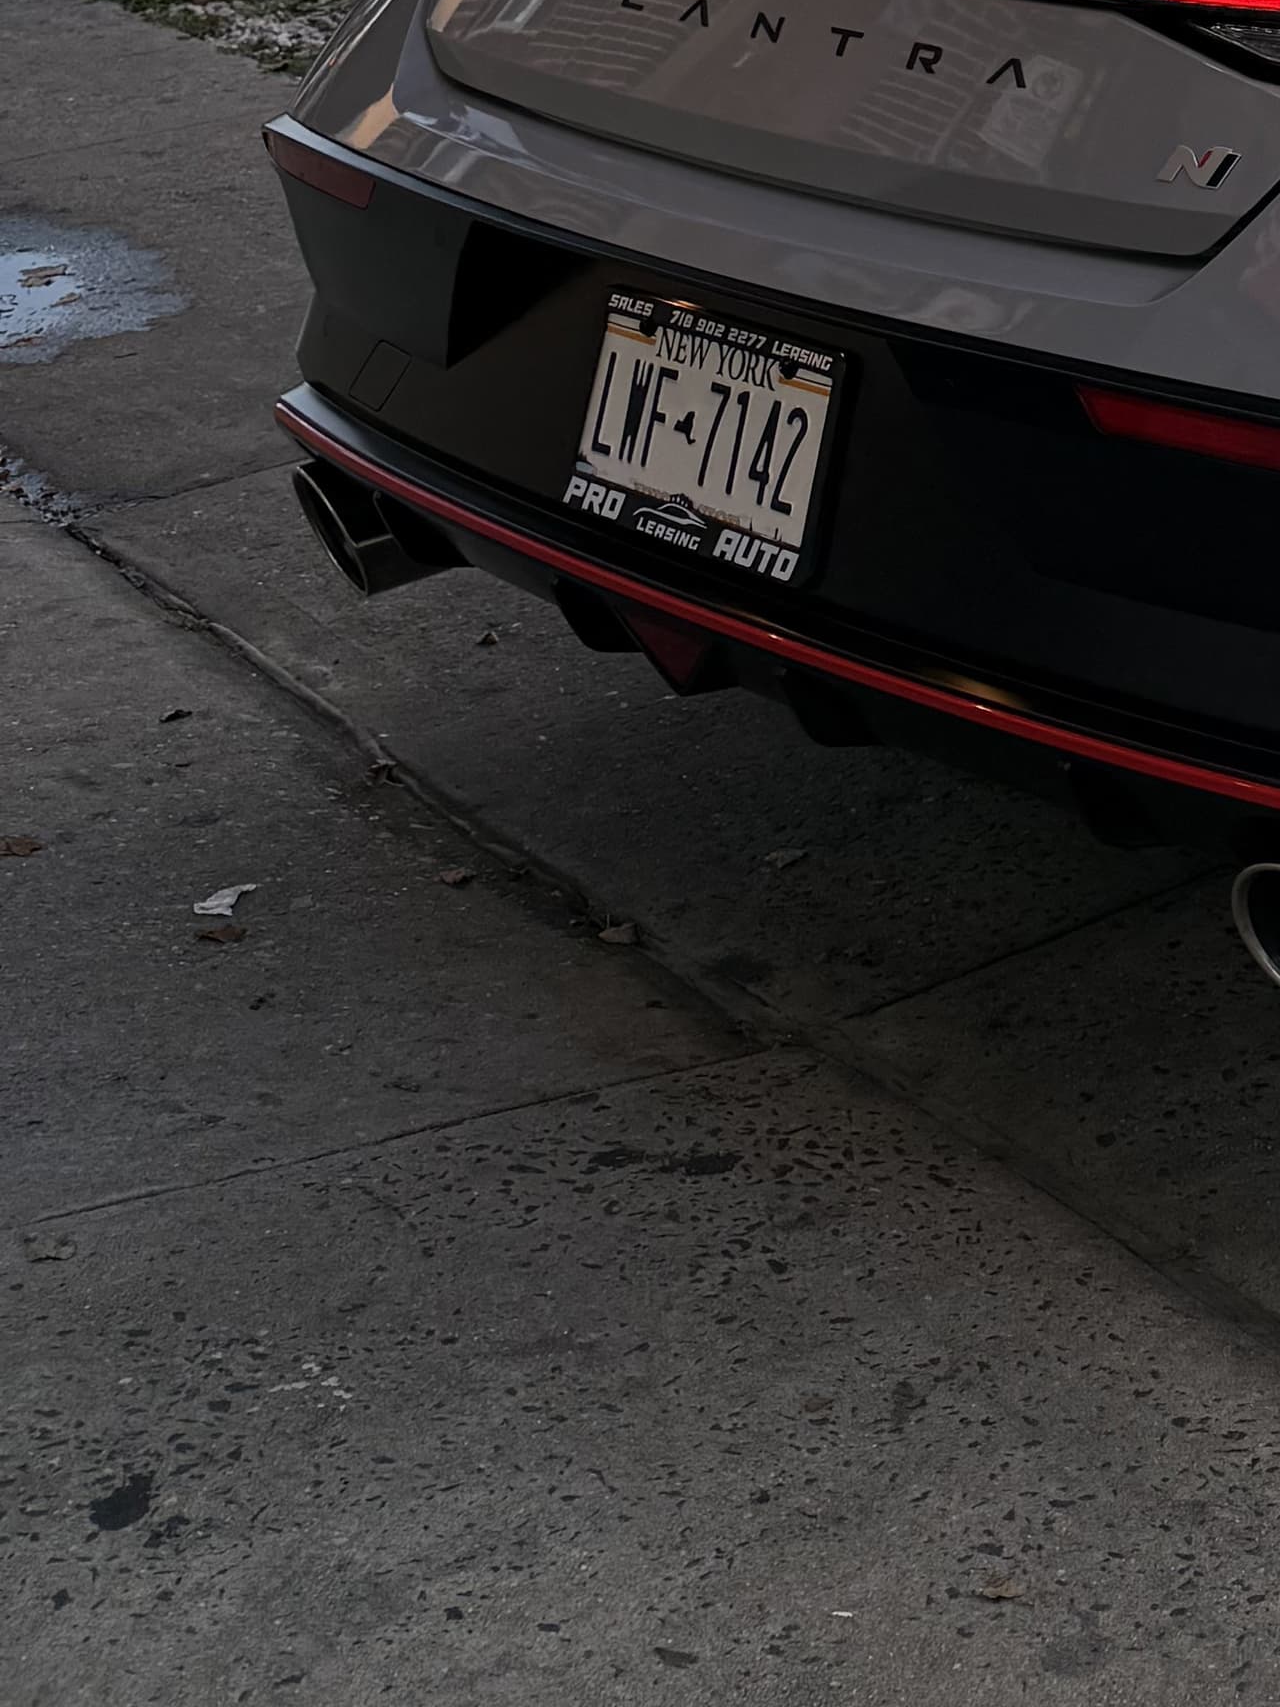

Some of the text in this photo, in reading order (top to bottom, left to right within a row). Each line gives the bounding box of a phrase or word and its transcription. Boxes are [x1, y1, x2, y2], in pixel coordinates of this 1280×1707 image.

[608, 293, 834, 372] SALES 718 902 2277 LEASING
[656, 326, 782, 391] NEW YORK
[562, 475, 627, 521] PRO
[636, 516, 701, 551] LEASING
[712, 529, 800, 583] AUTO
